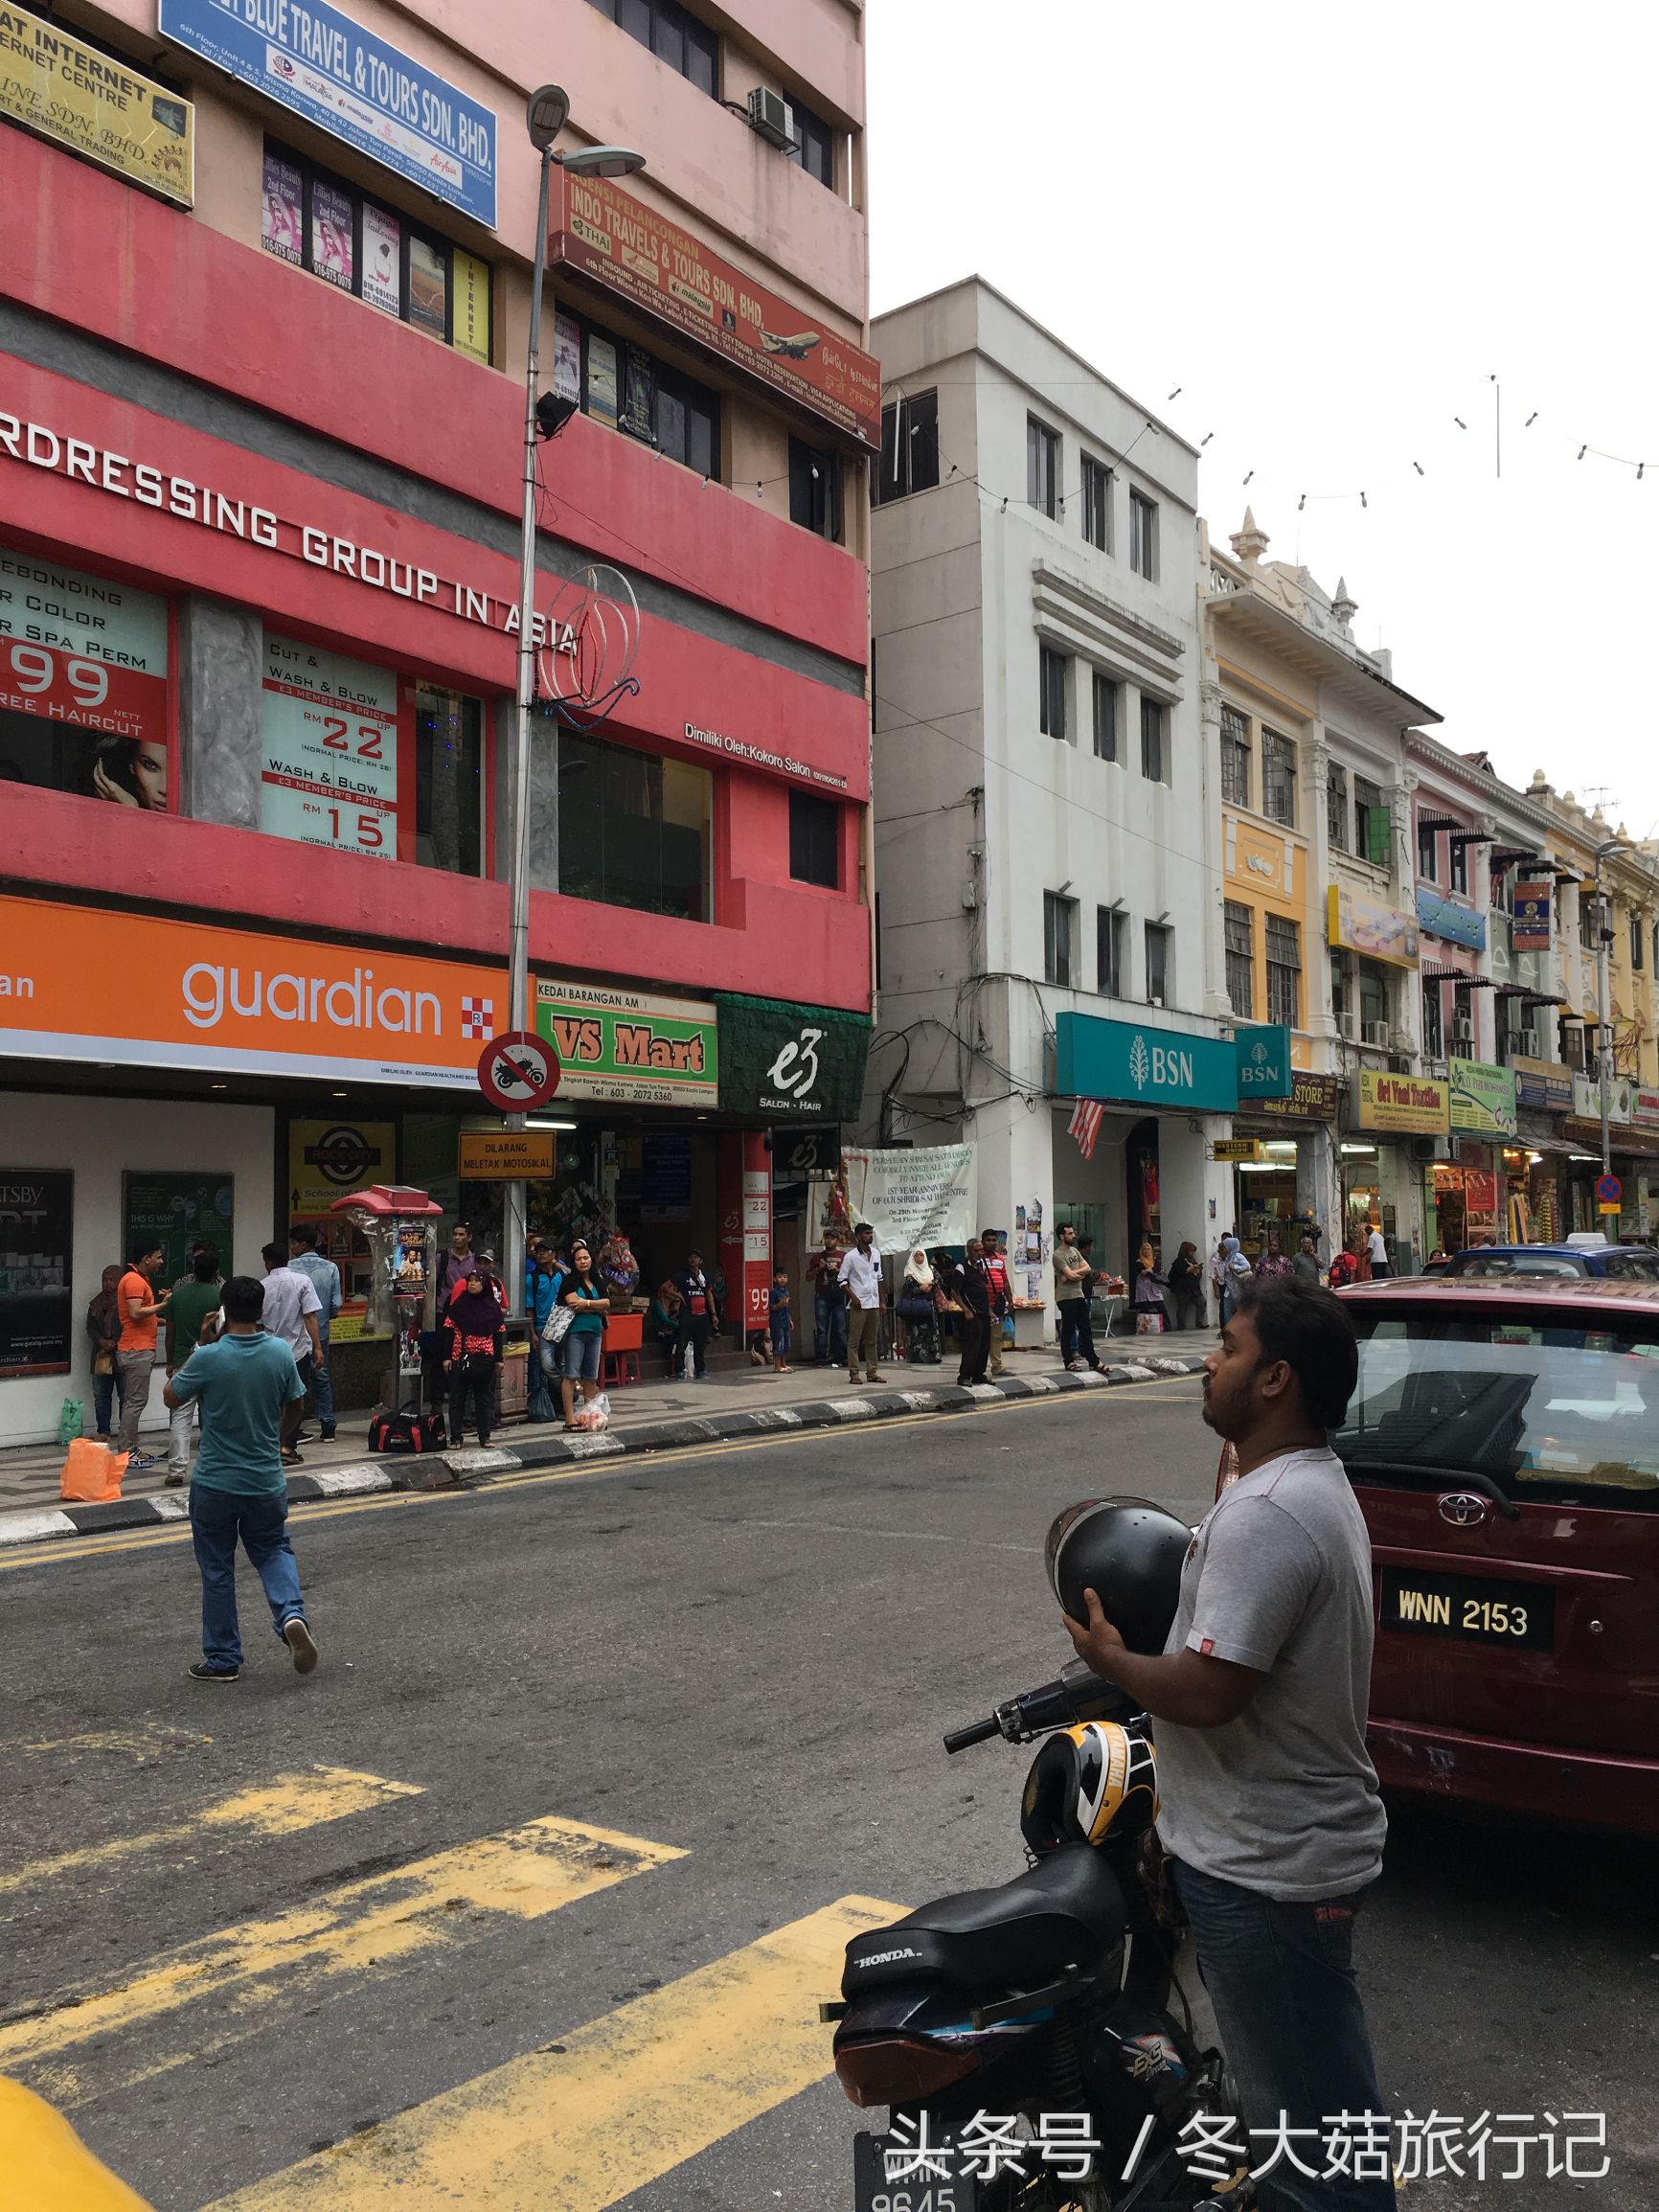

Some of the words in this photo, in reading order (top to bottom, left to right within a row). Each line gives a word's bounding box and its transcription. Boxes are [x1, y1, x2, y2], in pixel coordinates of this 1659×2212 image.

[35, 29, 147, 103] INTERNET
[200, 44, 212, 56] Tel
[261, 81, 279, 96] 2026
[281, 95, 300, 109] 2595
[61, 66, 127, 112] CENTRE
[290, 3, 351, 83] TRAVEL
[354, 46, 367, 93] &
[368, 54, 419, 125] TOURS
[421, 89, 455, 149] SDN.
[459, 112, 492, 171] BHD.
[179, 23, 194, 37] 6th
[221, 48, 239, 64] Unit
[263, 72, 289, 93] Wisma
[349, 124, 368, 141] Jalan
[369, 135, 382, 149] Tun
[428, 171, 447, 188] Kuala
[26, 108, 77, 140] GENERAL
[80, 135, 125, 165] TRADING
[46, 102, 95, 136] SDN.
[101, 128, 148, 164] BHD.
[267, 176, 279, 191] 2nd
[280, 182, 296, 201] Floor
[319, 203, 330, 217] 2nd
[331, 210, 346, 228] Floor
[616, 195, 699, 261] PELANCONGAN
[261, 236, 285, 260] 016-975
[286, 250, 302, 266] 0079
[585, 225, 610, 251] THAI
[571, 182, 602, 226] INDO
[604, 204, 658, 262] TRAVELS
[661, 242, 670, 269] &
[673, 248, 711, 296] TOURS
[714, 275, 738, 313] SDN.
[739, 292, 764, 331] BHD.
[313, 262, 337, 284] 016-975
[337, 274, 352, 291] 0079
[585, 257, 598, 269] 6th
[598, 263, 616, 281] Floor
[617, 275, 638, 295] Wisma
[665, 304, 684, 322] Lebuh
[466, 261, 475, 343] INTERNET
[602, 258, 632, 281] INBOUND
[648, 286, 680, 310] TICKETING
[683, 308, 718, 333] E-TICKETING
[757, 352, 773, 367] HOTEL
[773, 363, 808, 390] RESERVATION
[810, 385, 822, 399] VISA
[823, 395, 856, 421] APPLICATIONS
[0, 411, 277, 548] RDRESSING
[303, 525, 438, 603] GROUP
[455, 582, 488, 625] IN
[504, 604, 577, 657] ASIA
[1, 559, 123, 606] EBONDING
[26, 595, 105, 630] COLOR
[26, 624, 74, 650] SPA
[86, 640, 147, 670] PERM
[270, 643, 300, 662] CUT
[307, 655, 318, 668] &
[11, 644, 108, 707] 99
[269, 665, 313, 689] WASH
[320, 681, 331, 694] &
[338, 686, 377, 707] BLOW
[49, 701, 143, 737] HAIRCUT
[113, 709, 141, 721] NETT
[296, 689, 352, 713] MEMBER'S
[356, 705, 387, 721] PRICE
[304, 712, 321, 723] RM
[322, 717, 383, 760] 22
[376, 720, 391, 731] UP
[684, 722, 722, 749] Dimiliki
[784, 757, 810, 778] Salon
[269, 759, 313, 780] WASH
[320, 772, 331, 785] &
[338, 776, 377, 795] BLOW
[296, 781, 352, 801] MEMBER'S
[355, 795, 386, 809] PRICE
[303, 803, 321, 814] RM
[328, 809, 383, 848] 15
[376, 810, 391, 819] UP
[182, 961, 442, 1037] guardian
[538, 984, 566, 998] KEDAI
[569, 989, 622, 1007] BARANGAN
[625, 997, 639, 1009] AM
[552, 1015, 603, 1061] VS
[614, 1022, 705, 1073] Mart
[1152, 1047, 1193, 1088] BSN
[1241, 1066, 1279, 1083] BSN
[591, 1085, 603, 1097] Tel
[610, 1087, 625, 1099] 603
[633, 1089, 652, 1101] 2072
[653, 1091, 673, 1102] 5360
[760, 1097, 790, 1108] SALON
[799, 1101, 822, 1111] HAIR
[1294, 1084, 1323, 1105] STORE
[464, 1158, 500, 1170] MELETAK
[503, 1157, 552, 1169] MOTOSIKAL
[485, 1143, 527, 1153] DILARANG
[305, 1189, 338, 1198] School
[752, 1201, 767, 1211] 22
[872, 1197, 882, 1205] OF
[130, 1214, 147, 1223] THIS
[148, 1214, 155, 1222] IS
[156, 1213, 175, 1223] WHY
[753, 1237, 767, 1246] 15
[751, 1288, 769, 1311] 99
[1399, 1589, 1451, 1626] WNN
[1463, 1599, 1529, 1636] 2153
[859, 1948, 916, 1969] HONDA
